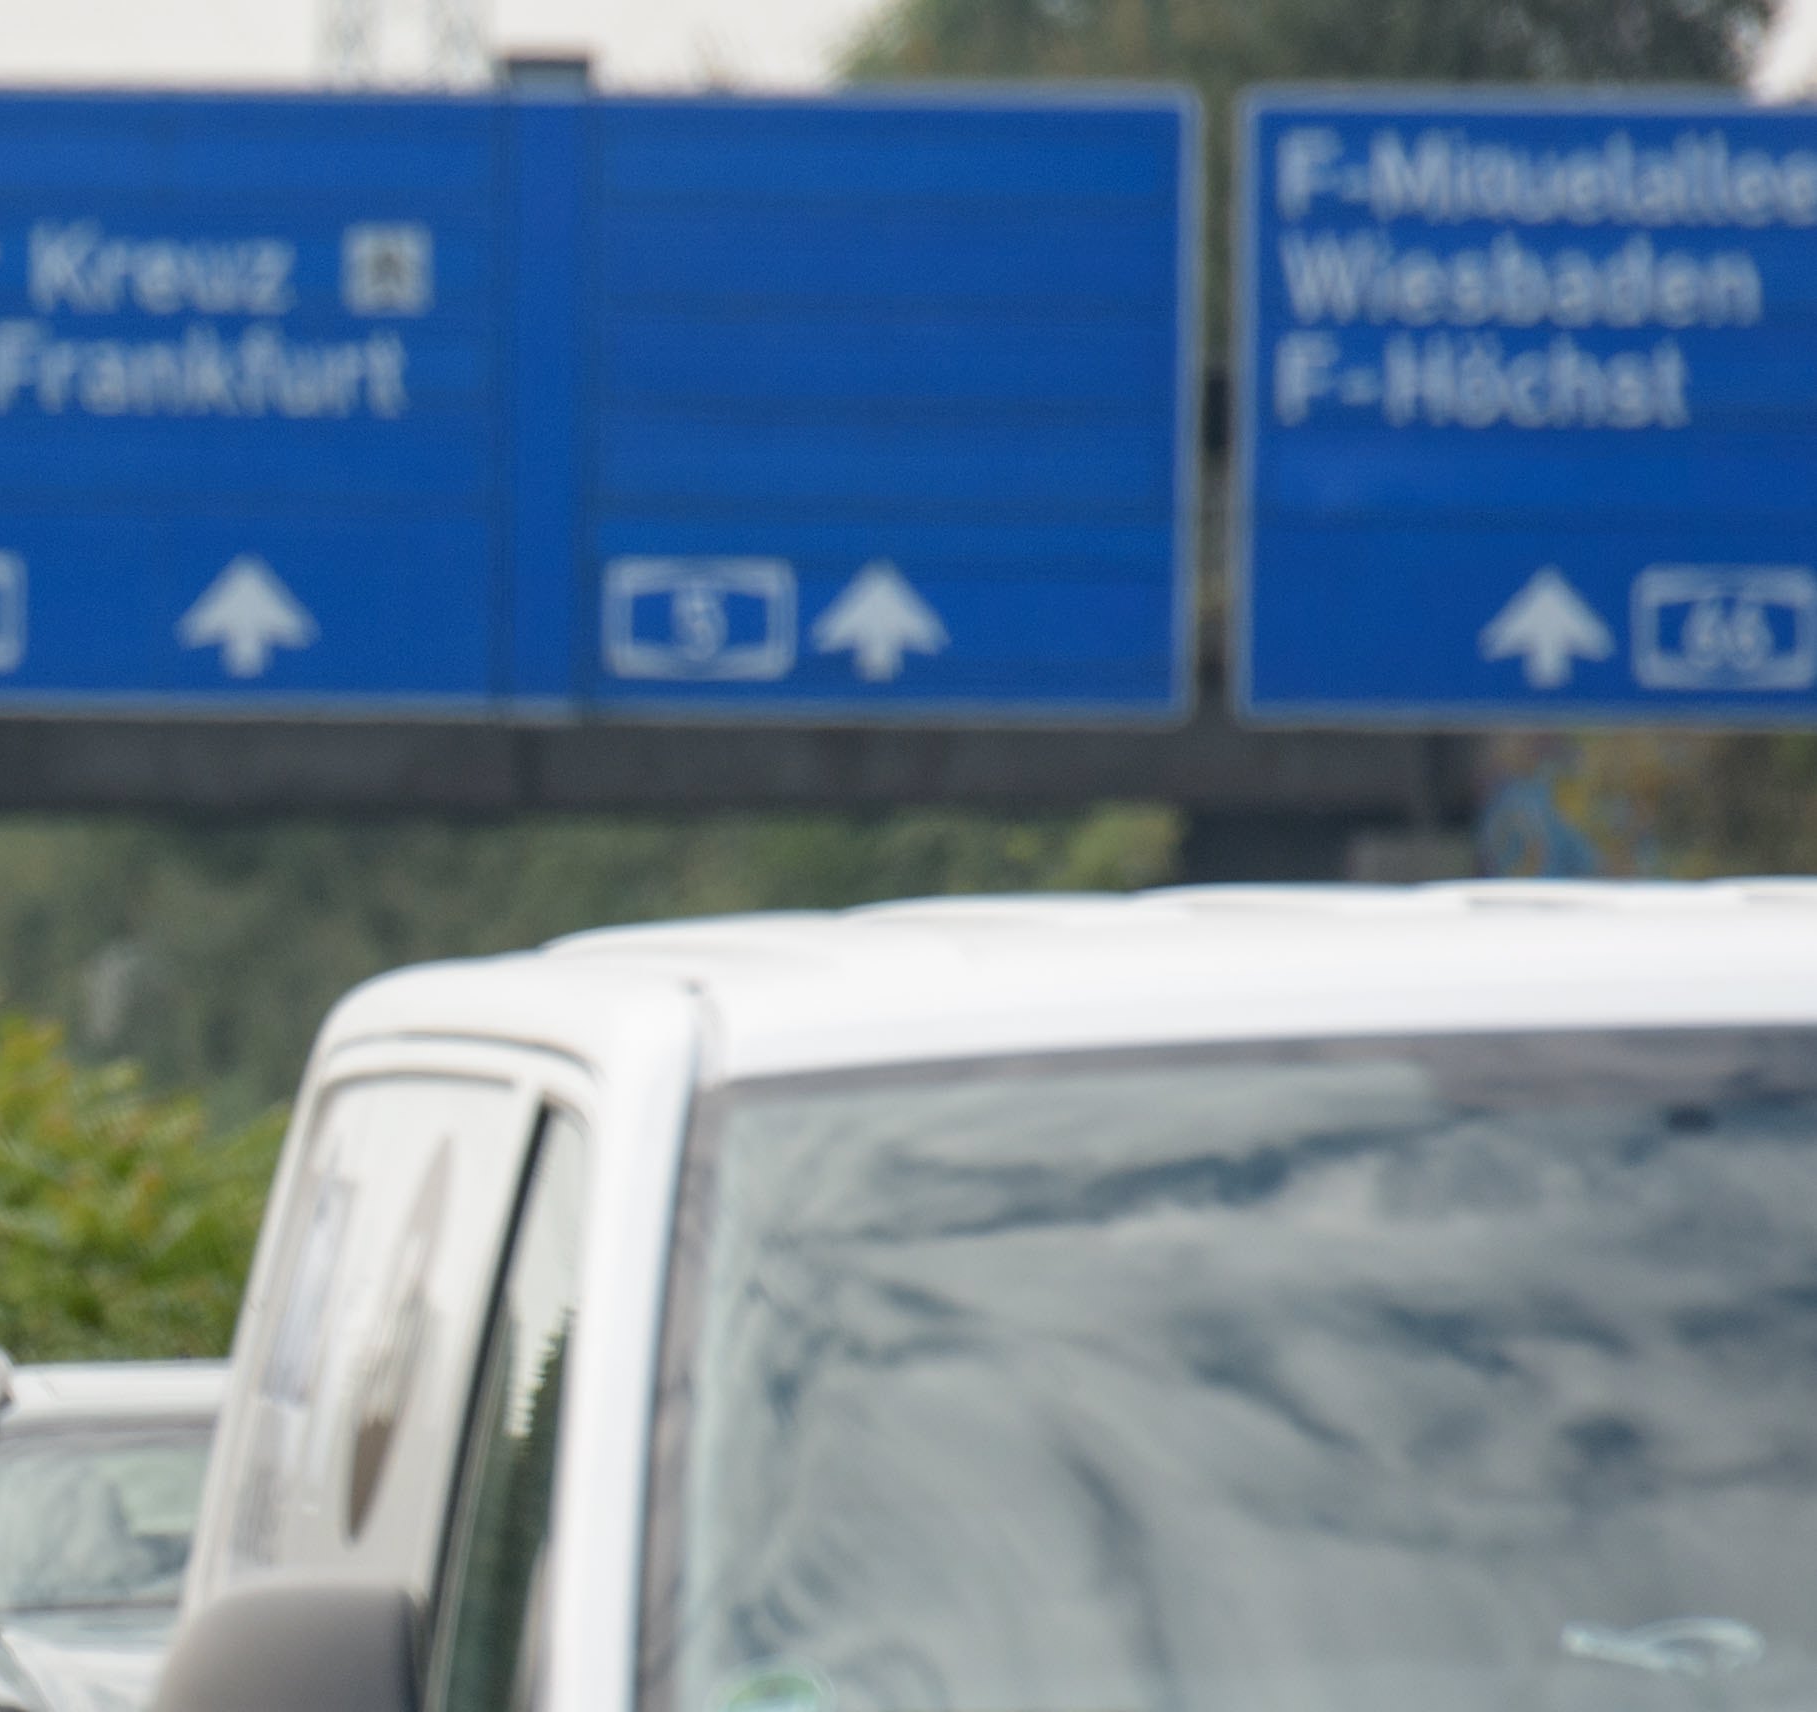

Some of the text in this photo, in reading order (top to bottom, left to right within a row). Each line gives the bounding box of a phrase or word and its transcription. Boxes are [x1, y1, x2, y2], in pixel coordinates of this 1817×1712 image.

[28, 218, 296, 316] Kreuz
[1281, 230, 1764, 328] Wiesbaden
[1275, 330, 1690, 430] F-Höchst
[674, 577, 727, 661] 5
[1682, 588, 1773, 671] 66
